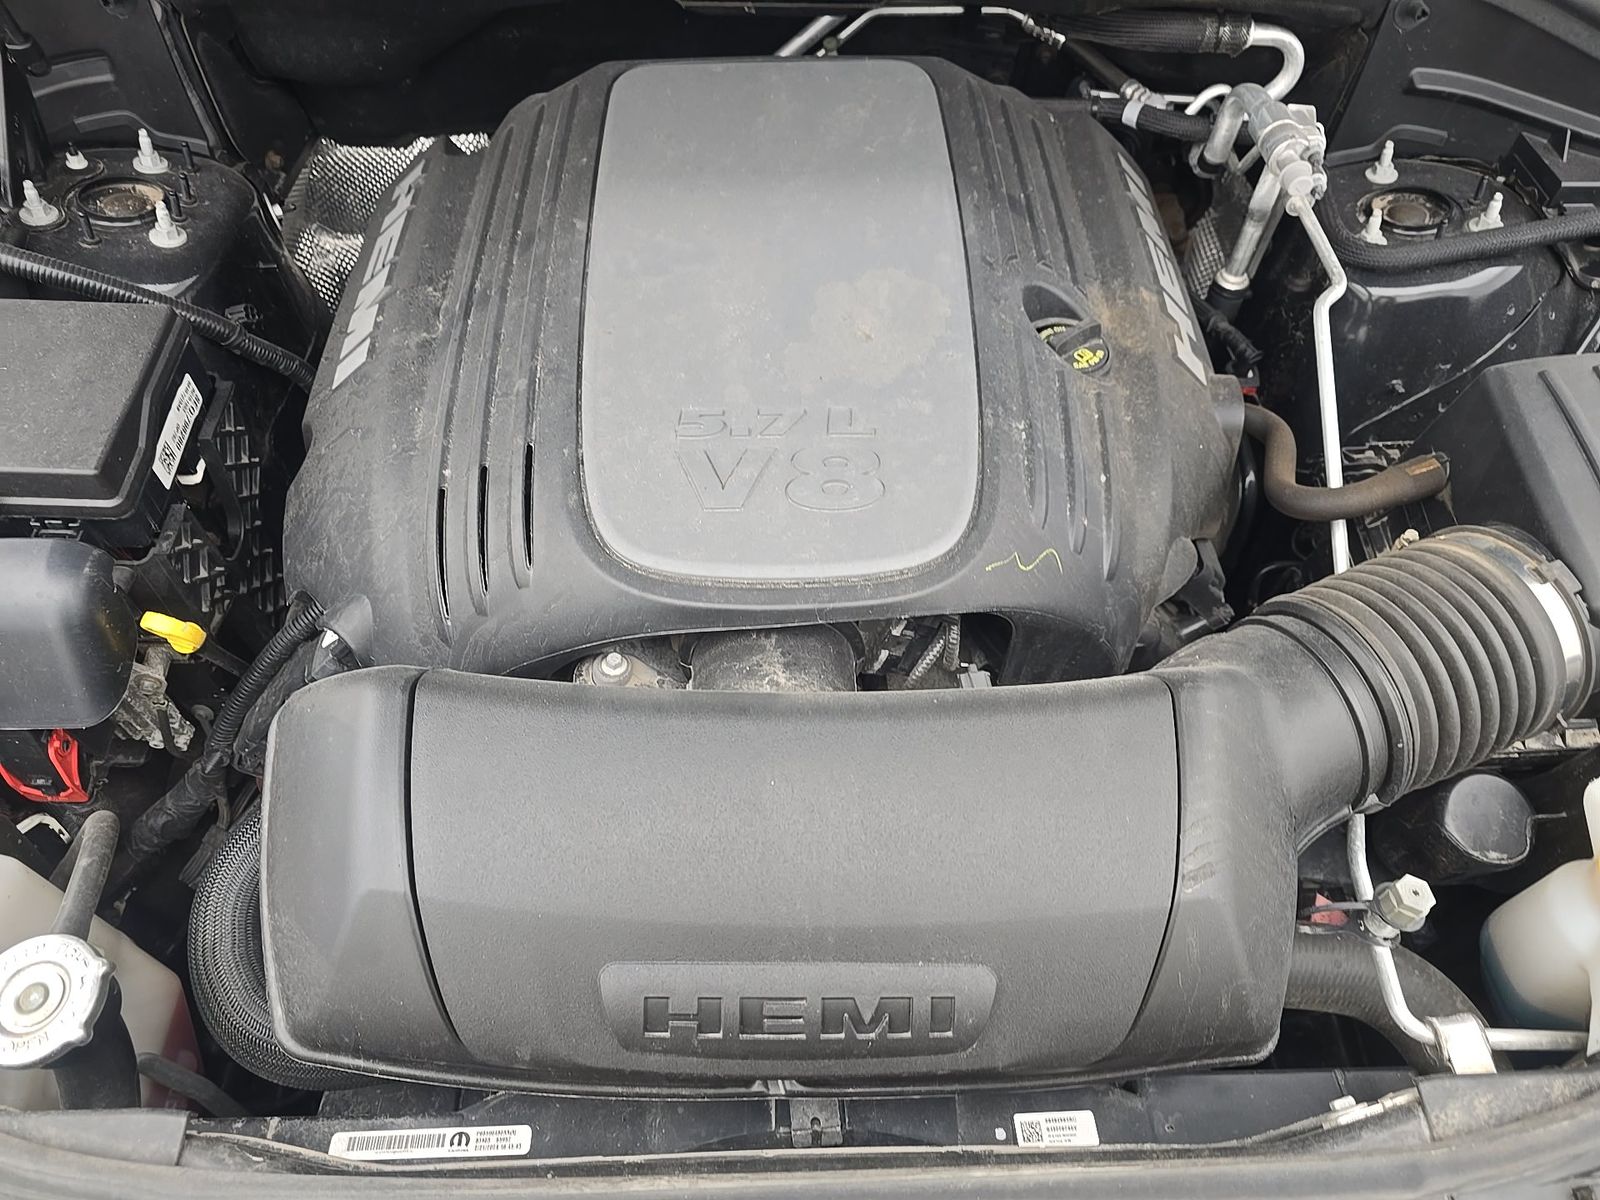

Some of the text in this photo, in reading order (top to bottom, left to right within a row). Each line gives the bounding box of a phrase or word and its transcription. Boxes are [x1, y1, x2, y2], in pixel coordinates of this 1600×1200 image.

[332, 159, 426, 391] HEMI
[1117, 151, 1207, 386] HEMI
[673, 446, 887, 513] V8
[643, 995, 957, 1040] HEMI
